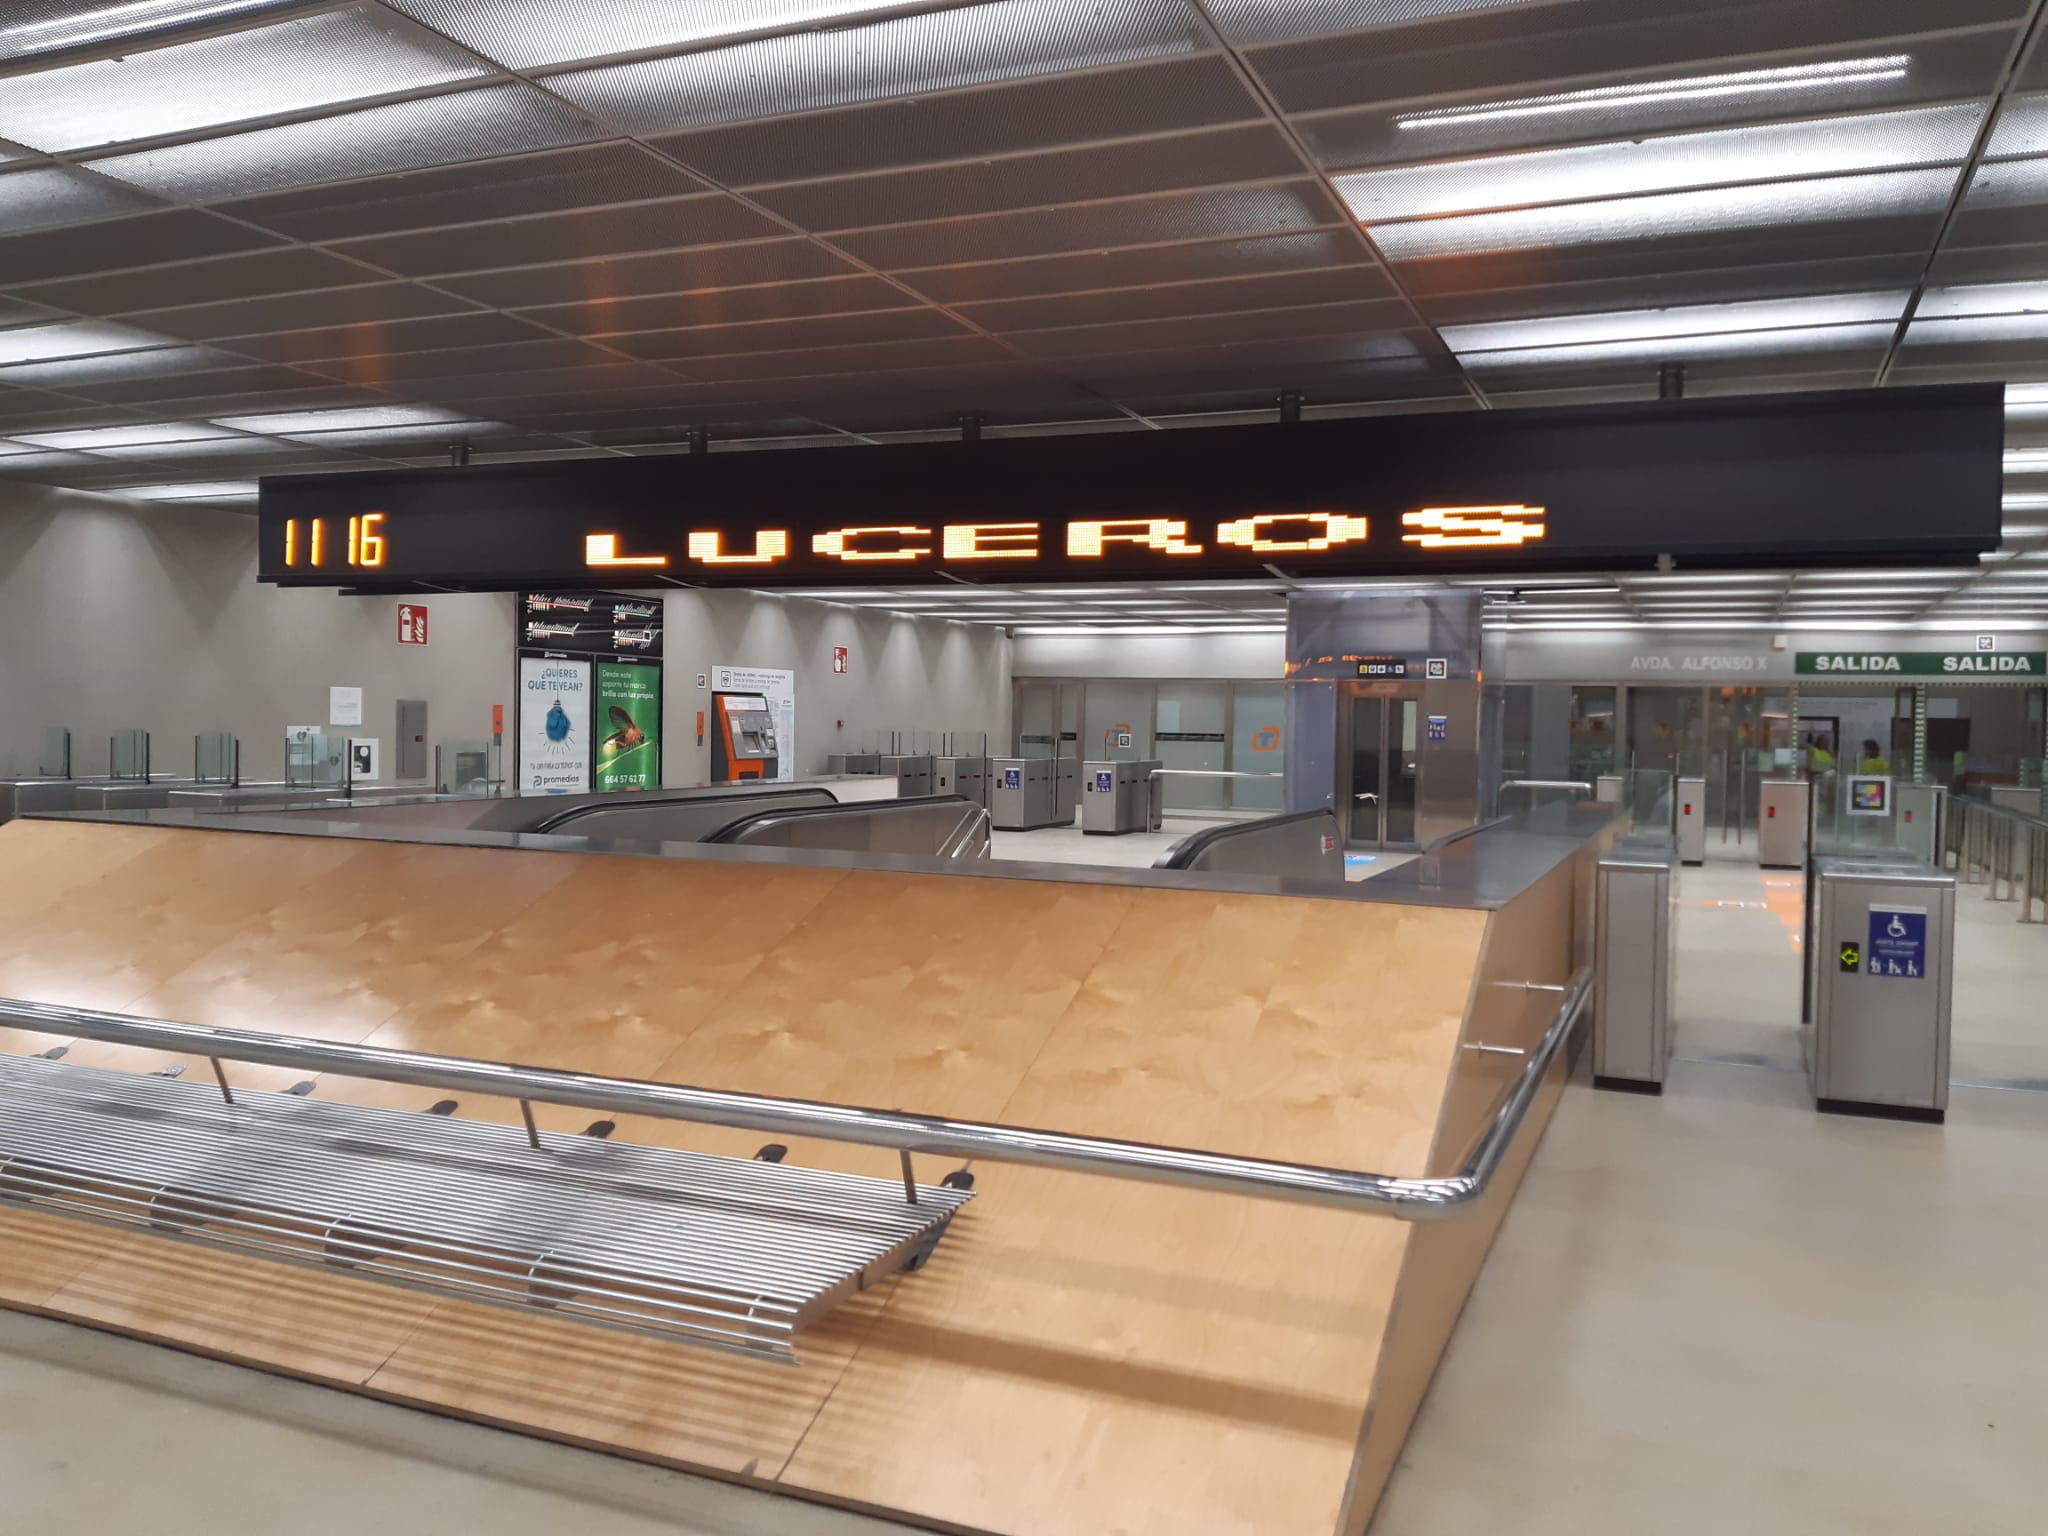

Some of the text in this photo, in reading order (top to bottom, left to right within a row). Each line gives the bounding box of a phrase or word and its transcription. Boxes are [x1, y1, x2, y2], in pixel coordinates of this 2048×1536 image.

[284, 512, 384, 567] 11 16
[584, 503, 1547, 567] LUCEROS
[1631, 655, 1768, 671] AVDA. ALFONSO X
[1815, 655, 1901, 672] SALIDA
[1942, 656, 2032, 672] SALIDA
[541, 668, 578, 680] ¿QUIERES
[528, 680, 583, 692] QUE TE VEAN?
[544, 774, 580, 786] promedios
[619, 774, 628, 783] 57
[638, 774, 646, 783] 77
